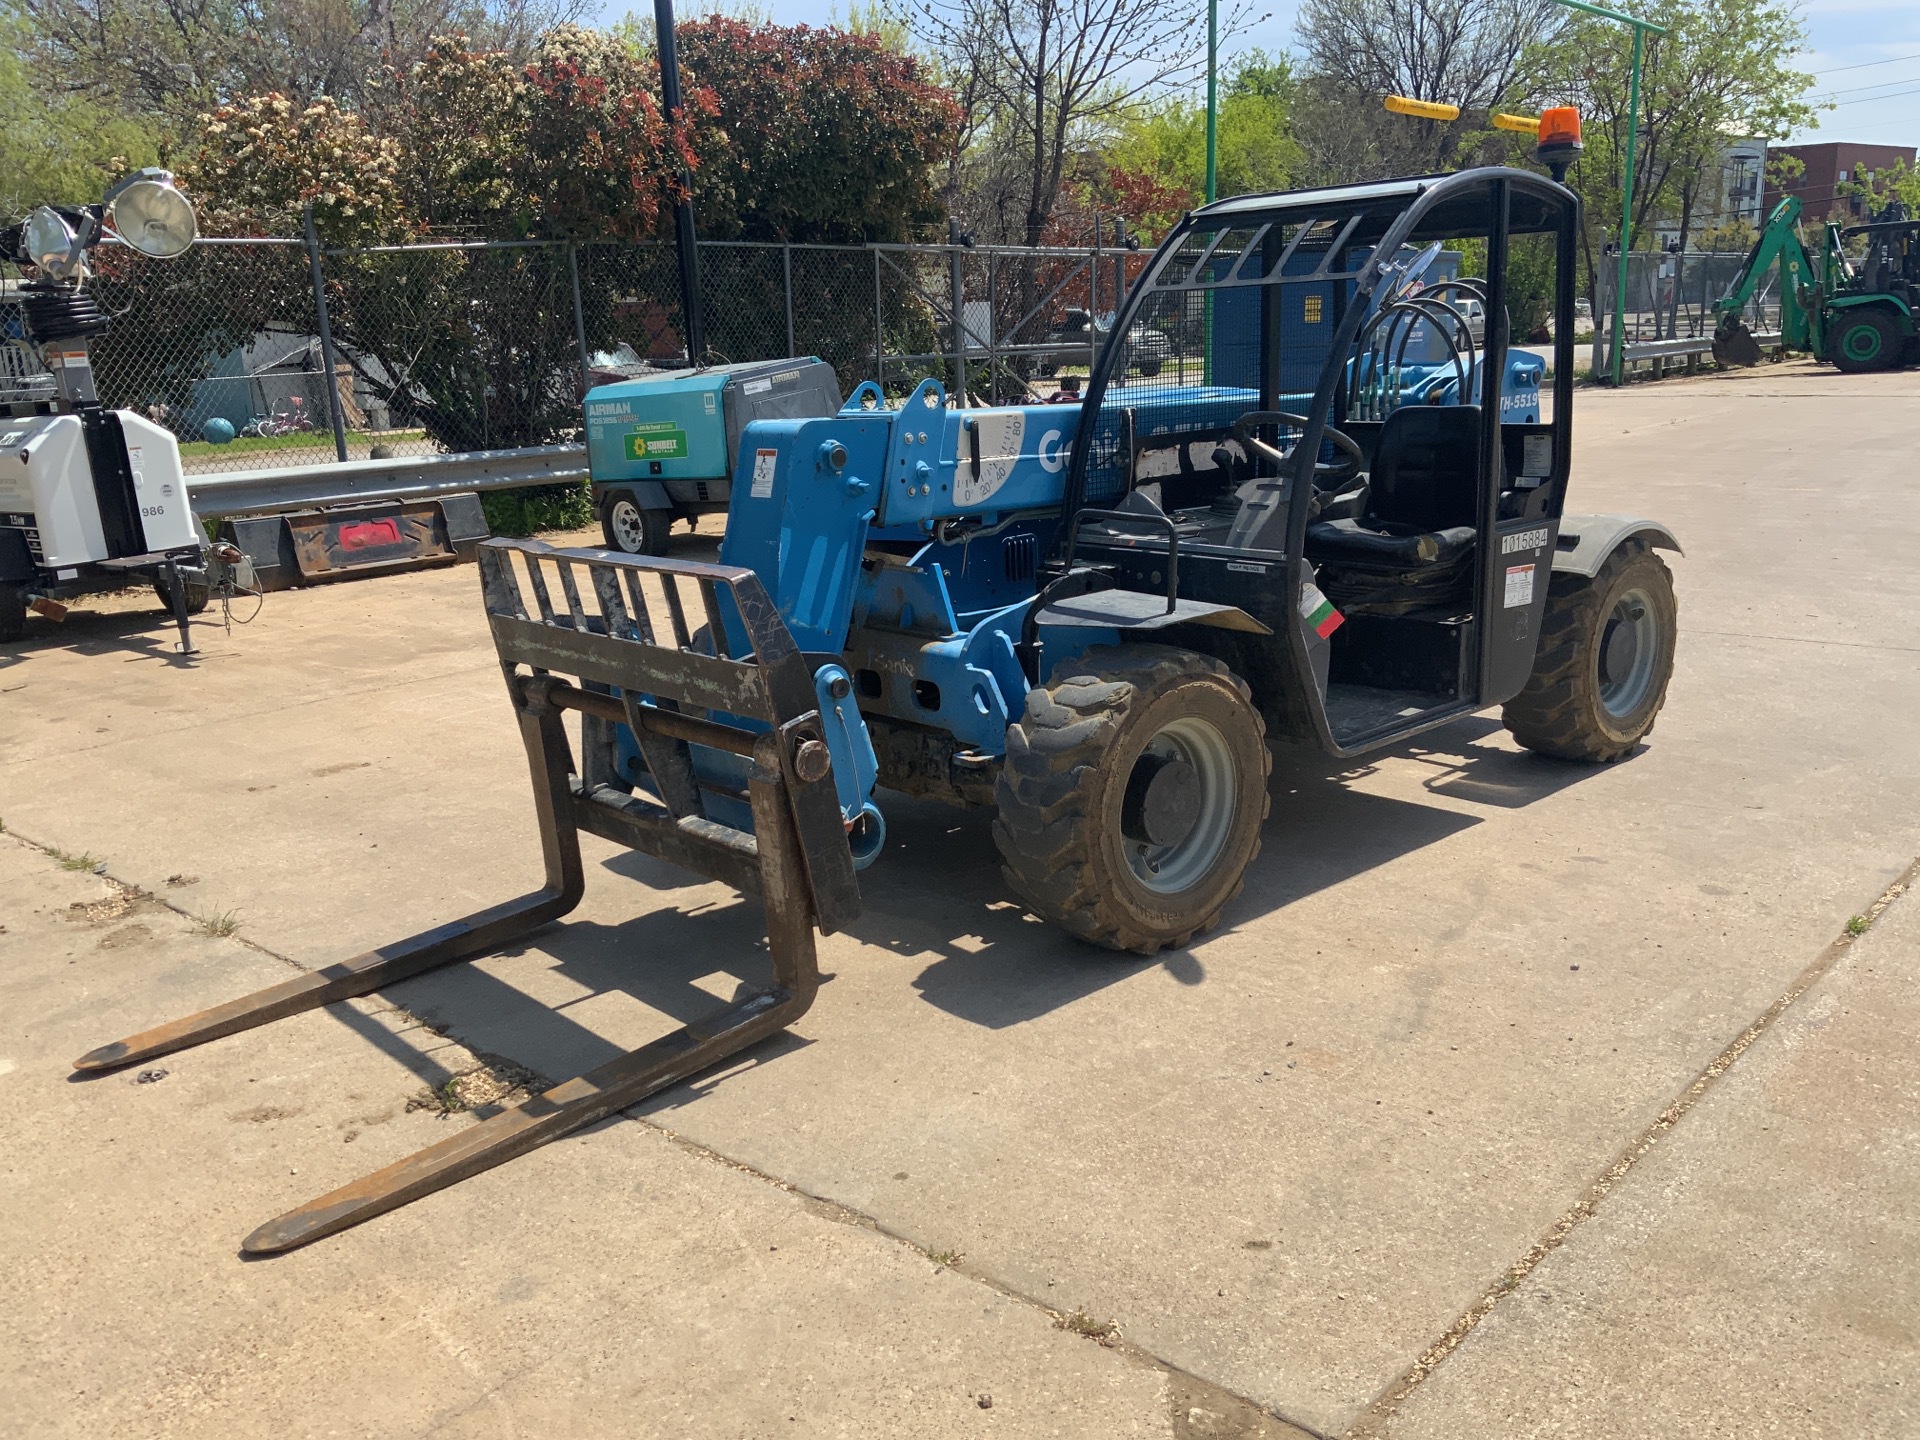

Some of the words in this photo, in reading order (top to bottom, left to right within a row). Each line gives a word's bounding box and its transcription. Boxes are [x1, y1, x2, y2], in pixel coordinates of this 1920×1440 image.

[772, 370, 800, 384] AIRMAN
[589, 402, 631, 416] AIRMAN
[646, 440, 677, 451] SUNBELT
[142, 505, 164, 517] 986
[1503, 529, 1547, 553] 1015884
